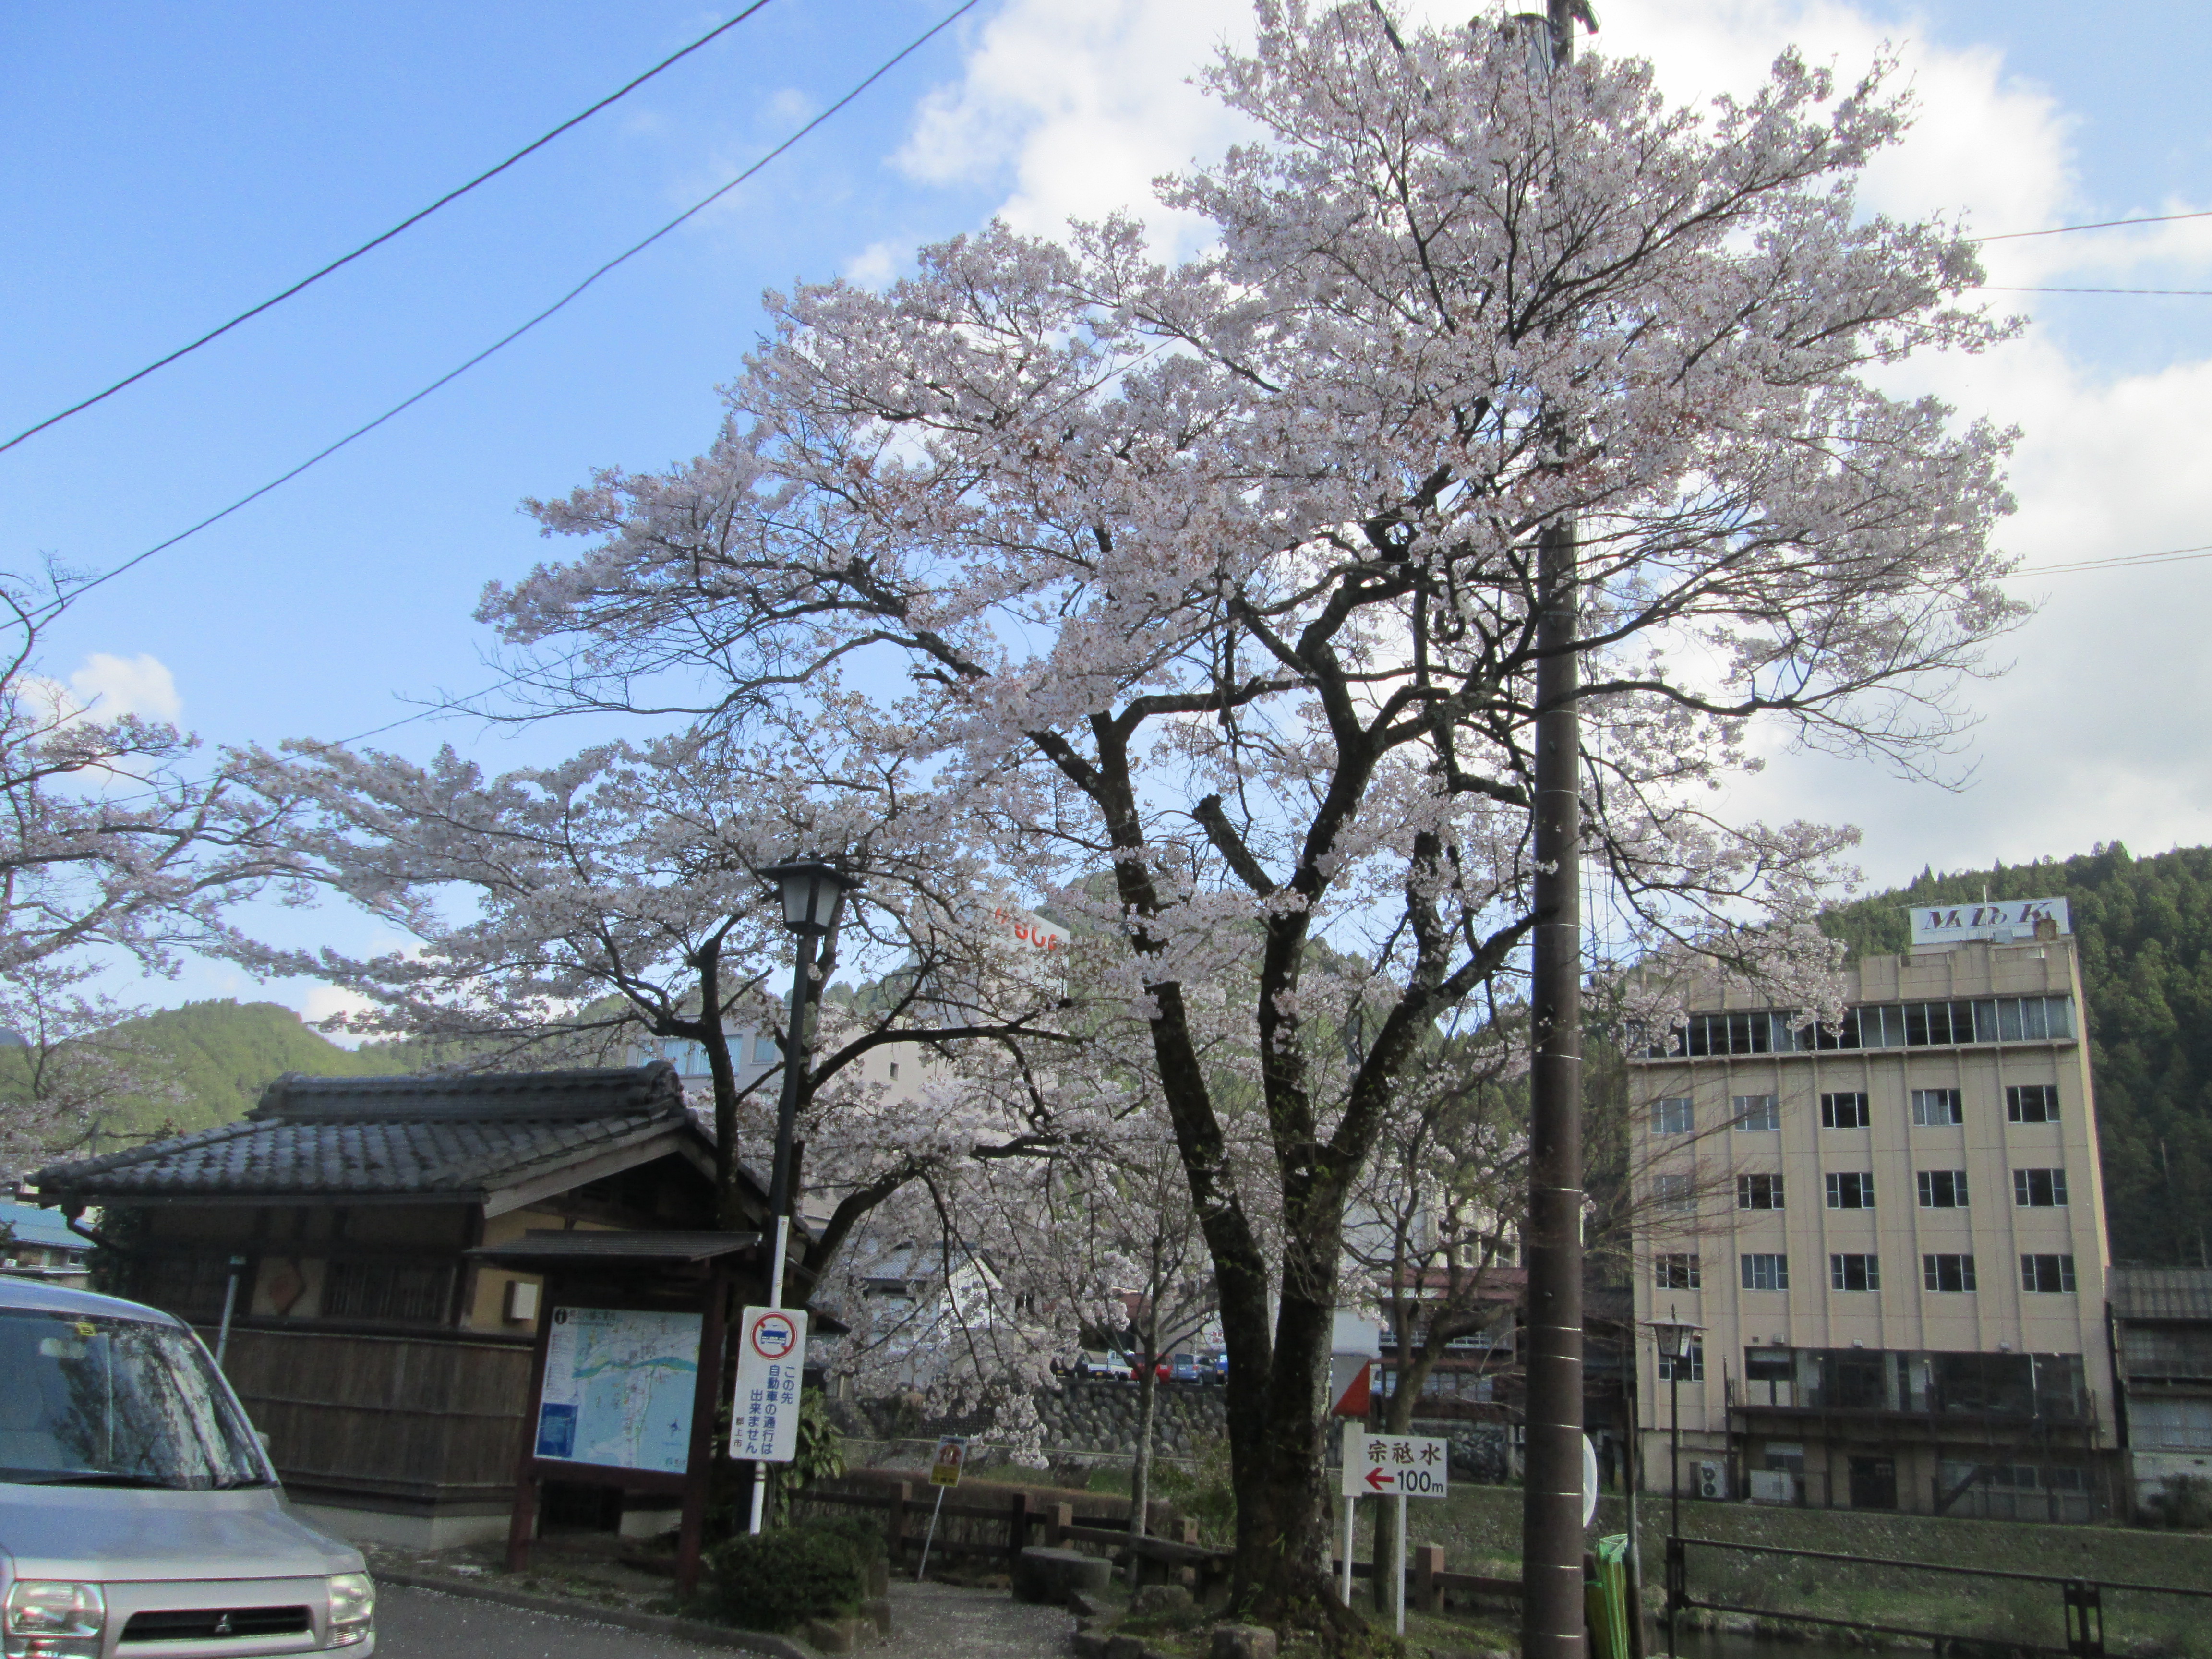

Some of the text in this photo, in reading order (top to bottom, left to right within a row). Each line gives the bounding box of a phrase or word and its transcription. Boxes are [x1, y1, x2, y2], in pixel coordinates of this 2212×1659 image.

[781, 1366, 795, 1405] この先
[746, 1389, 763, 1454] 出来ません
[761, 1365, 780, 1455] 自動車の通行は
[733, 1417, 744, 1448] 郡上市
[1397, 1469, 1443, 1493] 100m
